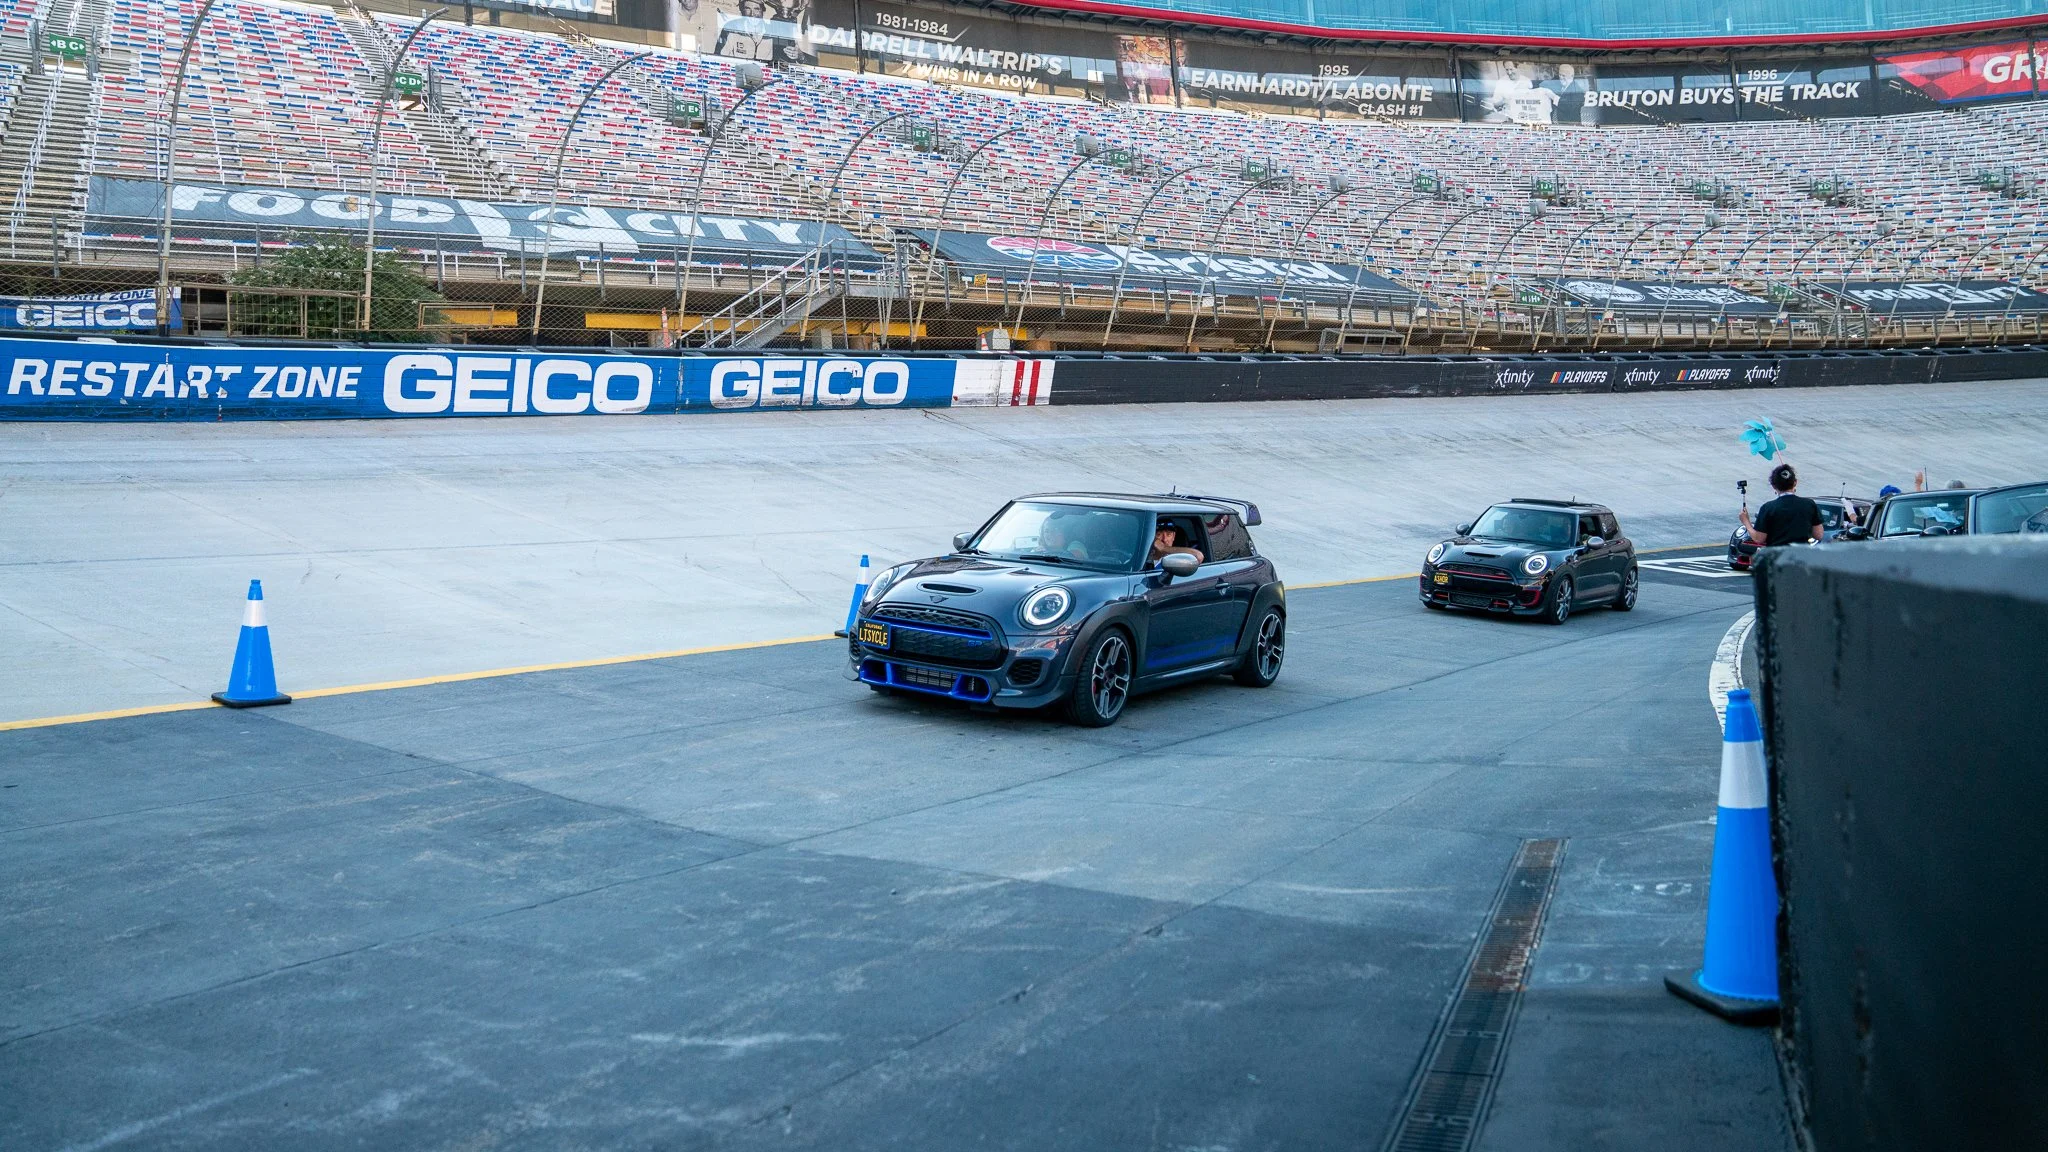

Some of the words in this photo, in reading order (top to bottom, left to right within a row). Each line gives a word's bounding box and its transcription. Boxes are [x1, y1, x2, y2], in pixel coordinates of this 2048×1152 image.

[876, 12, 949, 36] 1981-1984
[808, 24, 932, 59] DARRELL
[936, 42, 1064, 76] WALTRIP'S
[902, 61, 911, 74] 7
[916, 63, 959, 81] WINS
[962, 69, 980, 83] IN
[983, 72, 996, 85] A
[999, 74, 1039, 90] ROW
[1318, 64, 1350, 77] 1995
[1747, 69, 1778, 81] 1996
[1982, 52, 2048, 83] GR
[1190, 70, 1434, 102] EARNHARDT/LABONTE
[1584, 89, 1675, 107] BRUTON
[1679, 87, 1734, 105] BUYS
[1743, 85, 1784, 103] THE
[1789, 81, 1861, 100] TRACK
[1358, 102, 1406, 116] CLASH
[1409, 104, 1424, 117] #1
[162, 185, 457, 224] FOOD
[625, 212, 803, 244] CITY
[1105, 244, 1350, 282] Bristol
[108, 288, 155, 301] ZONE
[7, 358, 243, 399] RESTART
[248, 366, 362, 399] ZONE
[383, 354, 653, 414] GEICO
[709, 359, 910, 409] GEICO
[1494, 368, 1535, 388] xfinity
[1562, 371, 1608, 384] PLAYOFFS
[1623, 367, 1661, 386] xfinity
[1687, 368, 1731, 381] PLAYOFFS
